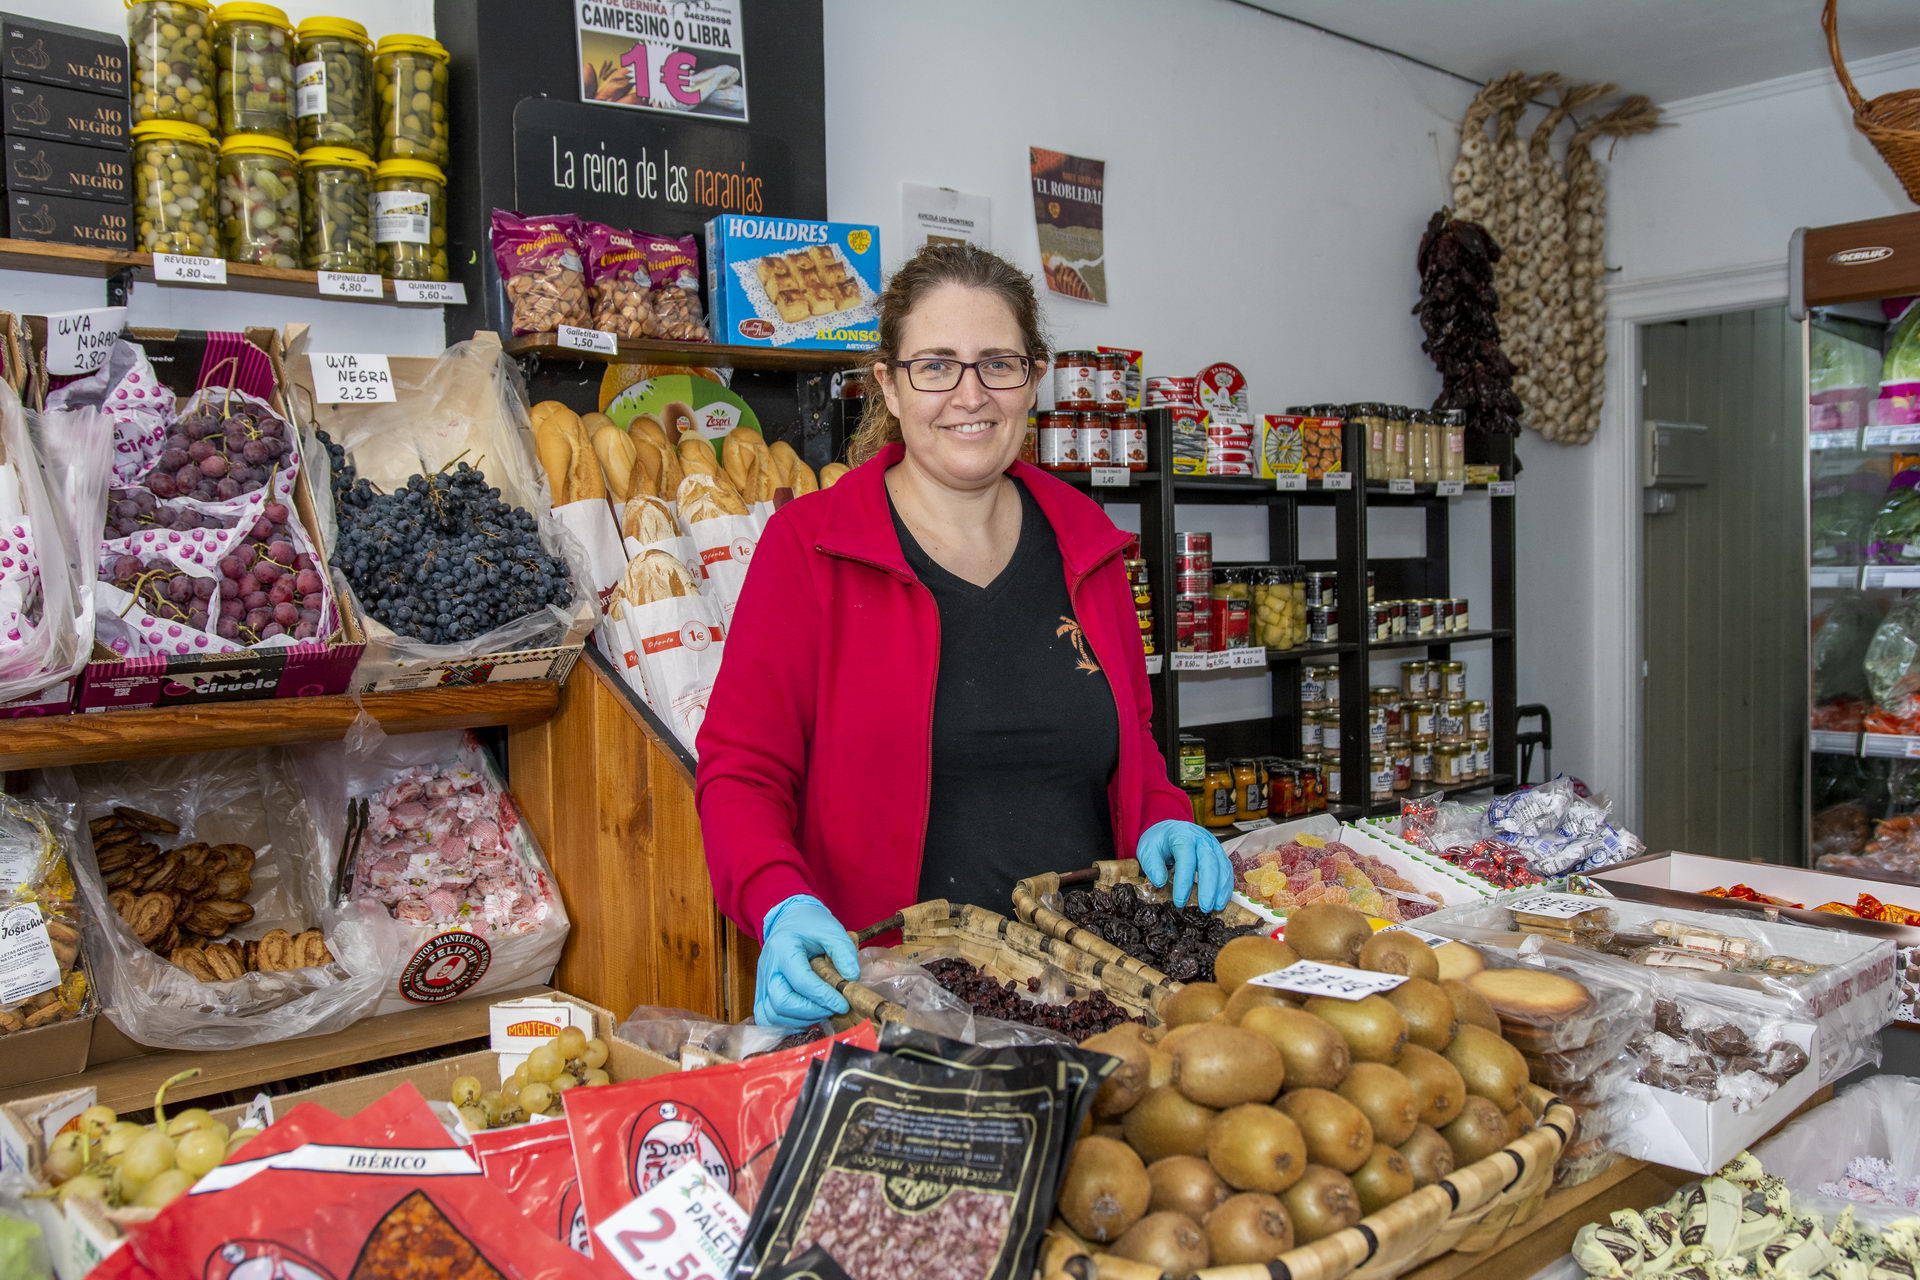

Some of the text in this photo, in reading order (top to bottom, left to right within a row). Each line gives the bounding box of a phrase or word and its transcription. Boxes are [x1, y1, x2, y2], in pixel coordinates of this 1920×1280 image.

[622, 0, 668, 16] GERNIKA
[581, 4, 732, 49] CAMPESINO O LIBRA
[94, 53, 122, 70] AJO
[66, 62, 122, 84] NEGRO
[94, 107, 122, 123] AJO
[66, 116, 122, 137] NEGRO
[95, 161, 123, 177] AJO
[552, 135, 763, 216] La reina de las naranjas
[68, 172, 124, 191] NEGRO
[99, 214, 127, 228] AJO
[72, 225, 127, 242] NEGRO
[728, 218, 829, 243] HOJALDRES
[609, 235, 635, 248] CORAL
[650, 243, 682, 252] CORAL
[163, 255, 210, 267] REVUELTO
[175, 267, 202, 279] 4,80
[327, 273, 367, 283] PEPINILLO
[339, 282, 362, 293] 4,80
[408, 282, 447, 291] QUIMBITO
[418, 290, 440, 300] 5,60
[58, 314, 91, 336] UVA
[566, 327, 600, 339] Galletitas
[572, 337, 593, 348] 1,50
[816, 329, 881, 343] ALONSO
[74, 351, 107, 370] 2,80
[325, 355, 358, 369] UVA
[338, 369, 389, 384] NEGRA
[340, 386, 378, 401] 2,25
[705, 415, 731, 428] Zespri
[737, 545, 751, 556] 1€
[648, 629, 705, 648] Oferta 1€
[195, 678, 278, 695] Ciruelo
[1, 918, 44, 940] Josechu
[402, 943, 434, 983] EXQUISITOS
[434, 934, 487, 951] MANTECADOS
[428, 945, 474, 963] FELIPE
[644, 1138, 696, 1159] Don
[348, 1151, 426, 1170] IBÉRICO
[712, 1201, 728, 1218] La
